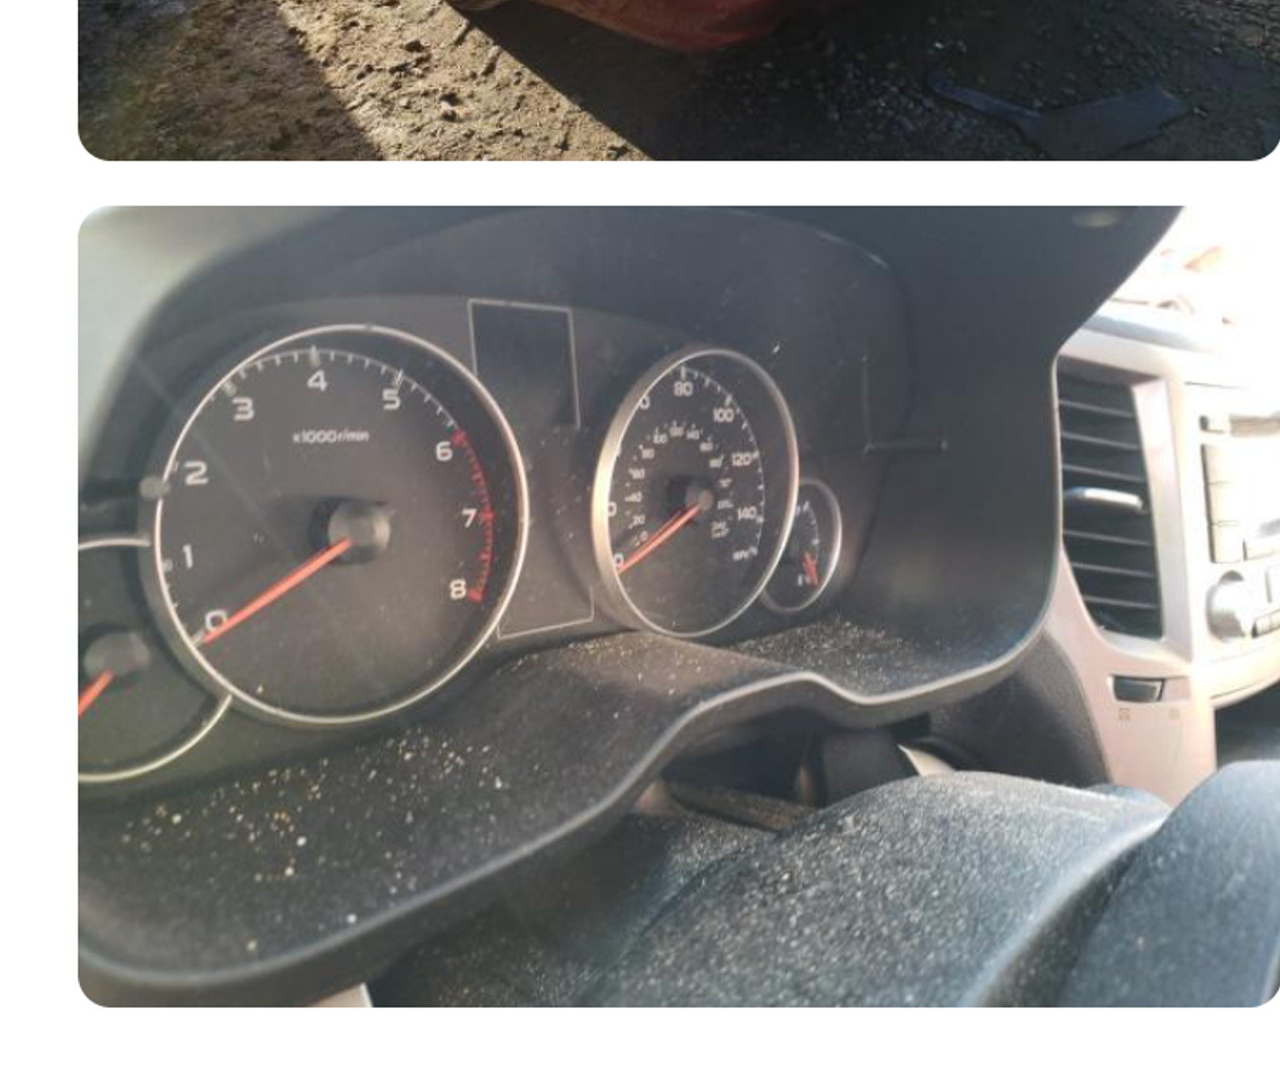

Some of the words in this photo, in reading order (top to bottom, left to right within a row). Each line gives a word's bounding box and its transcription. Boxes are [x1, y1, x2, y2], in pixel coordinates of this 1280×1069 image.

[307, 370, 328, 392] 4
[674, 381, 693, 397] 80
[232, 397, 254, 421] 3
[382, 389, 401, 410] 5
[714, 407, 734, 423] 100
[436, 441, 453, 461] 6
[732, 451, 751, 467] 120
[184, 460, 208, 485] 2
[462, 508, 478, 528] 7
[738, 506, 757, 521] 140
[183, 544, 194, 569] 1
[450, 579, 467, 599] 8
[205, 609, 228, 631] 0
